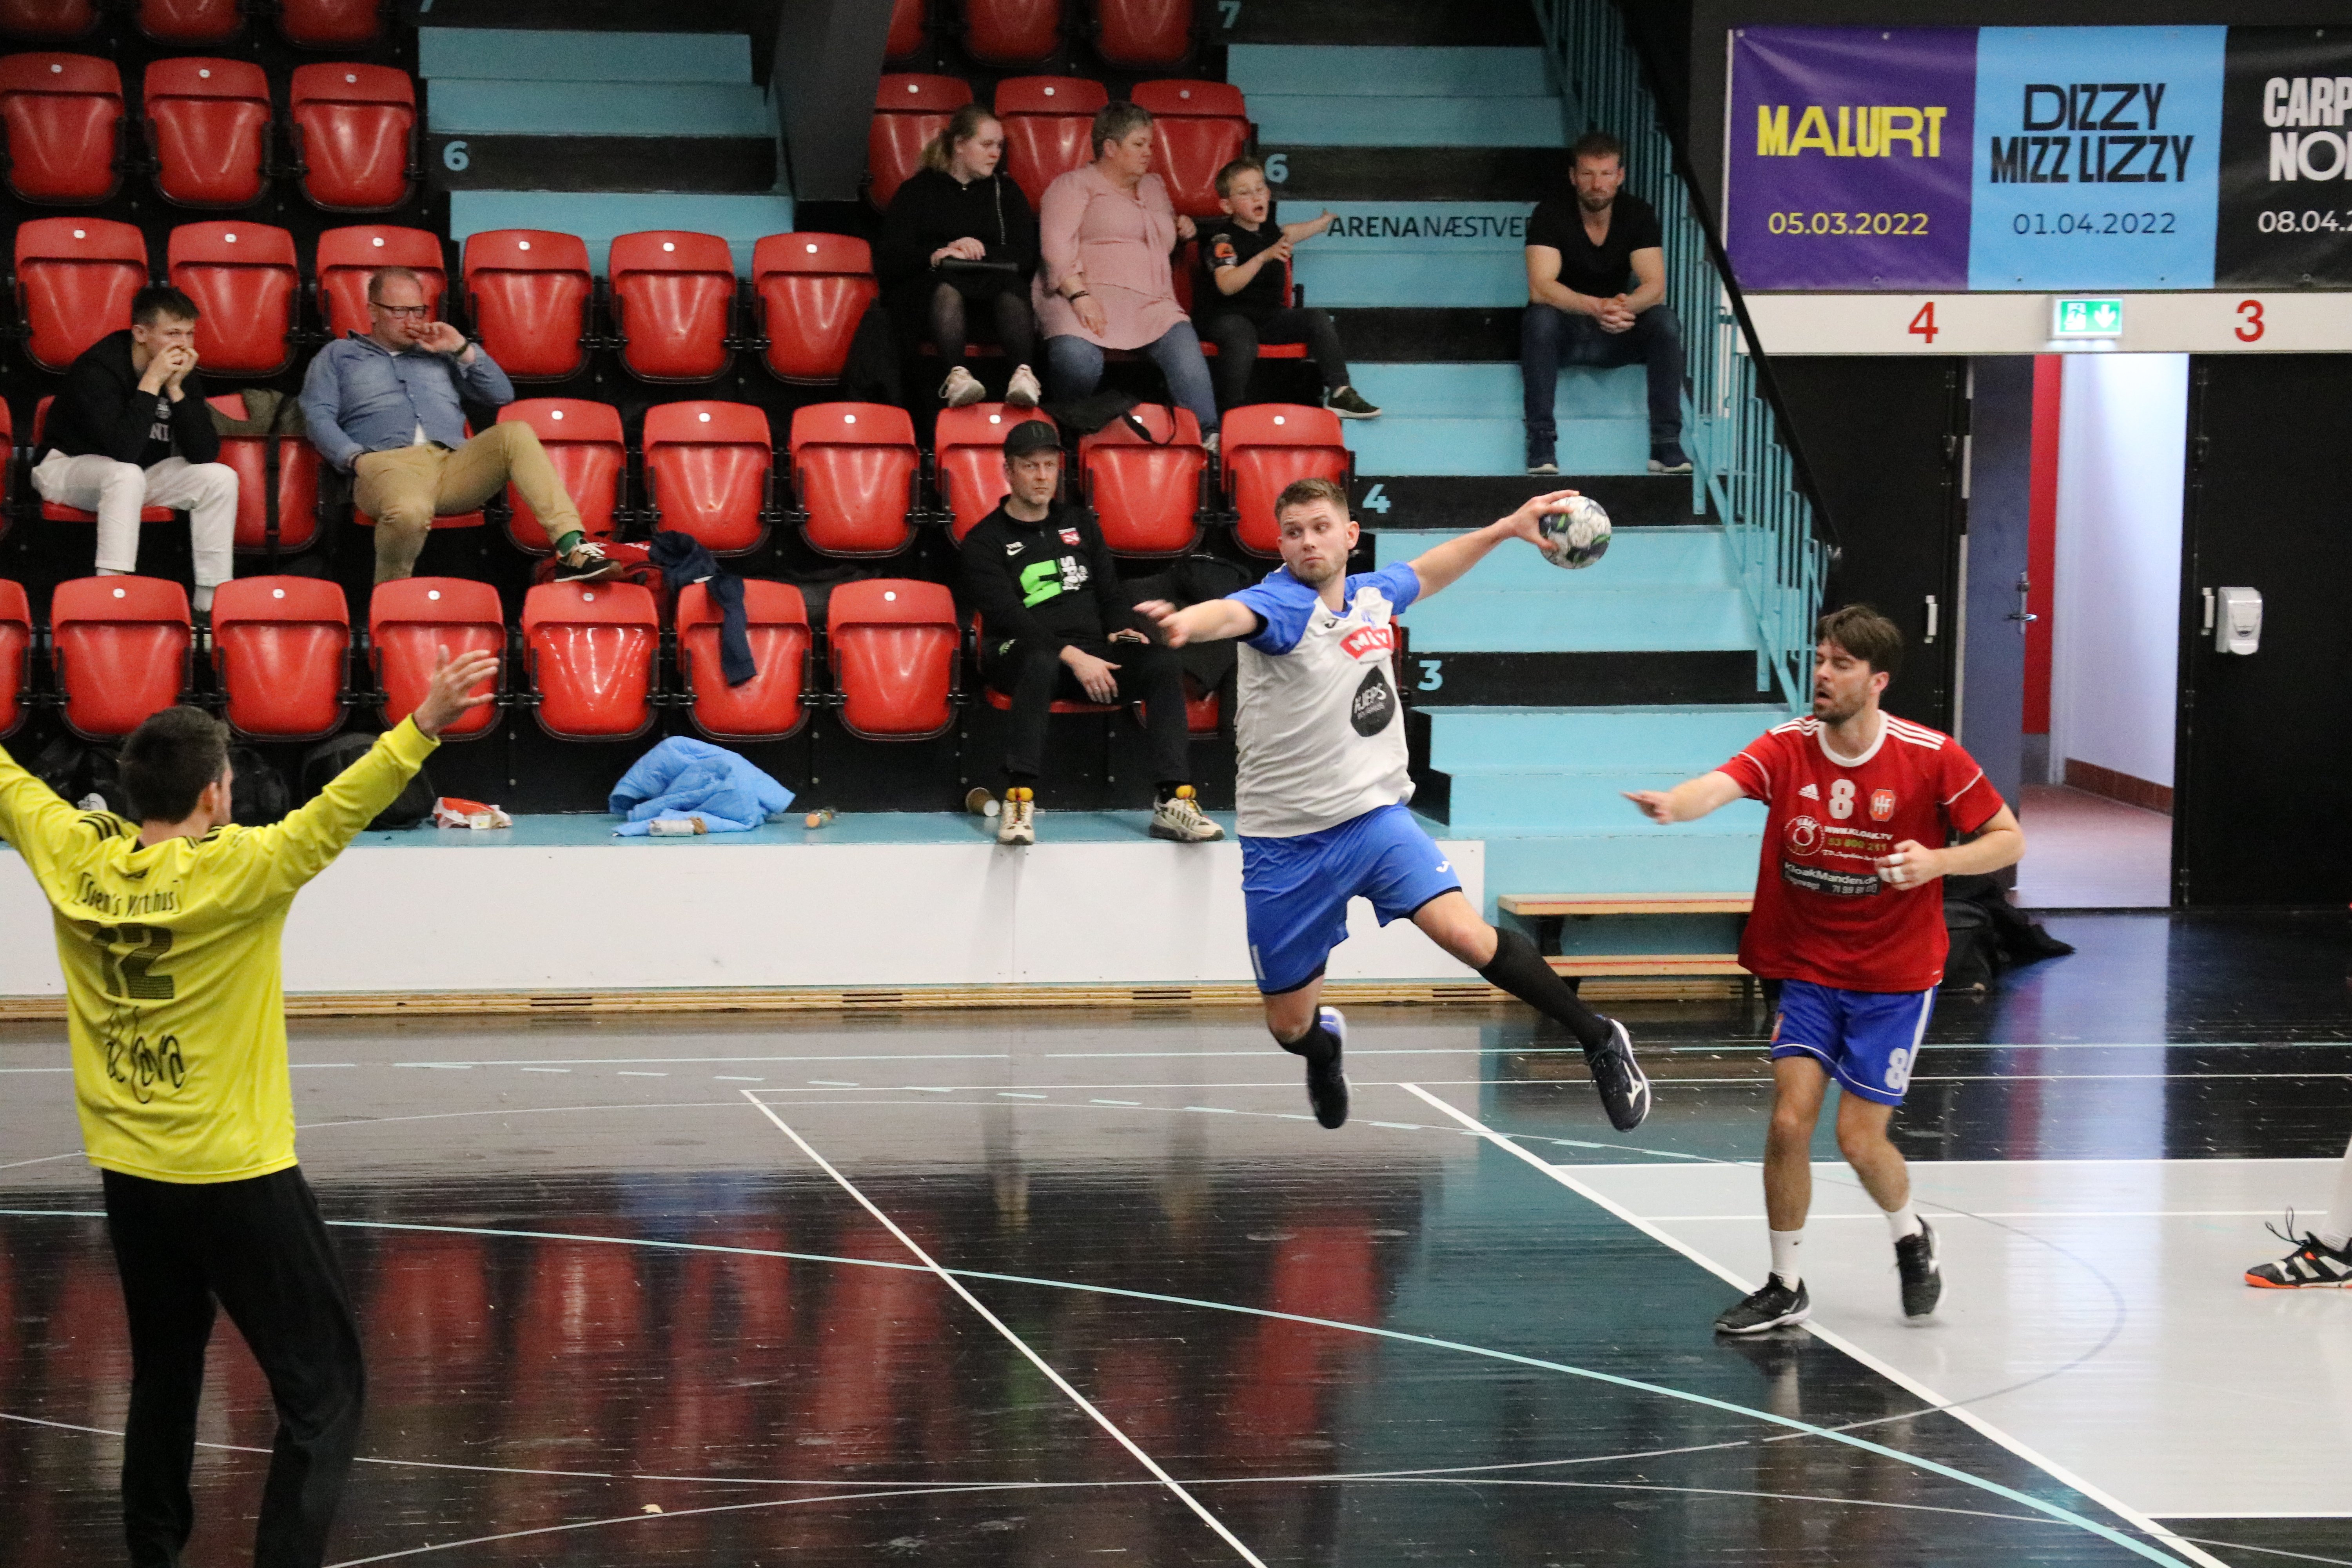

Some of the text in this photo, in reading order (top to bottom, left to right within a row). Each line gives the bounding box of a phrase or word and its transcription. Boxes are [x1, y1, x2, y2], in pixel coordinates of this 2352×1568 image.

[1218, 0, 1240, 28] 7
[2023, 83, 2166, 132] DIZZY
[2263, 77, 2352, 126] CARP
[1757, 105, 1947, 157] MALURT
[443, 141, 469, 171] 6
[1265, 154, 1289, 183] 6
[1990, 135, 2194, 183] MIZZ LIZZY
[1769, 212, 1929, 235] 05.03.2022
[2013, 212, 2176, 235] 01.04.2022
[1908, 302, 1939, 344] 4
[2234, 299, 2265, 343] 3
[1362, 484, 1391, 514] 4
[1417, 660, 1443, 691] 3
[1829, 779, 1856, 820] 8
[1884, 1047, 1909, 1089] 8
